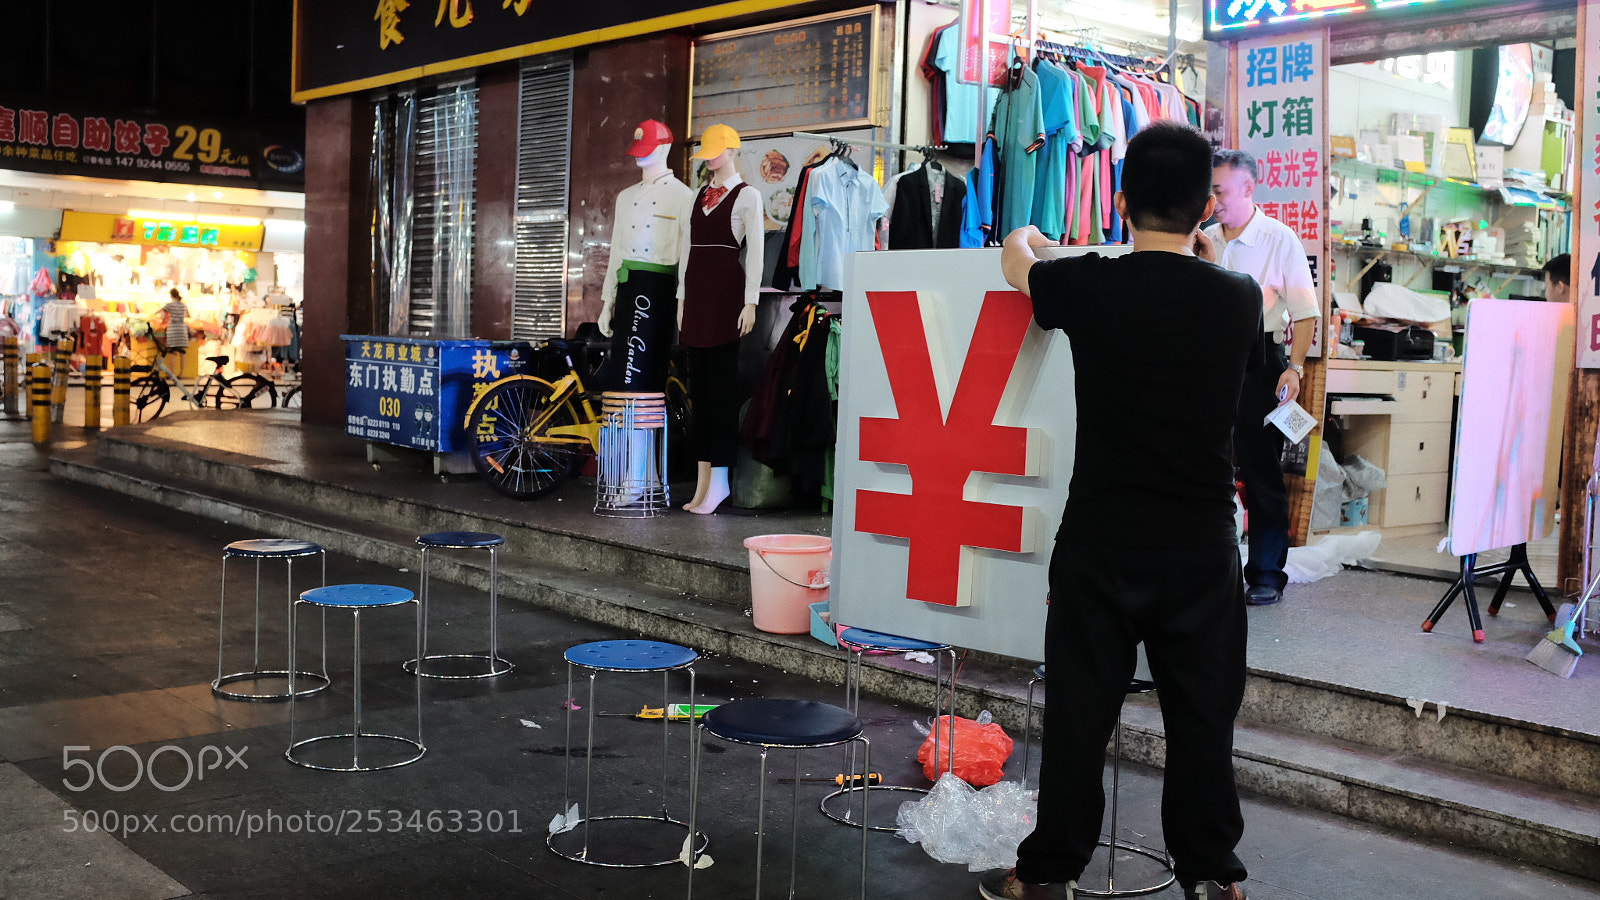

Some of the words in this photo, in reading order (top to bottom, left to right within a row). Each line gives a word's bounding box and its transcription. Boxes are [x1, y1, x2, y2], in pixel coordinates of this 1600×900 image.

[1246, 42, 1314, 87] 招牌
[1246, 96, 1314, 139] 灯箱
[0, 145, 78, 163] 余种菜品任吃
[115, 156, 133, 167] 147
[137, 158, 163, 170] 9244
[165, 161, 190, 172] 0555
[1257, 148, 1319, 189] D发光字
[1255, 200, 1319, 240] 喷绘
[632, 294, 651, 332] Olive
[361, 341, 422, 363] 天龙商业城
[625, 335, 646, 384] Garden
[349, 362, 434, 396] 东门执勤点
[379, 396, 401, 418] 030
[392, 422, 401, 431] 110
[855, 291, 1034, 606] ¥
